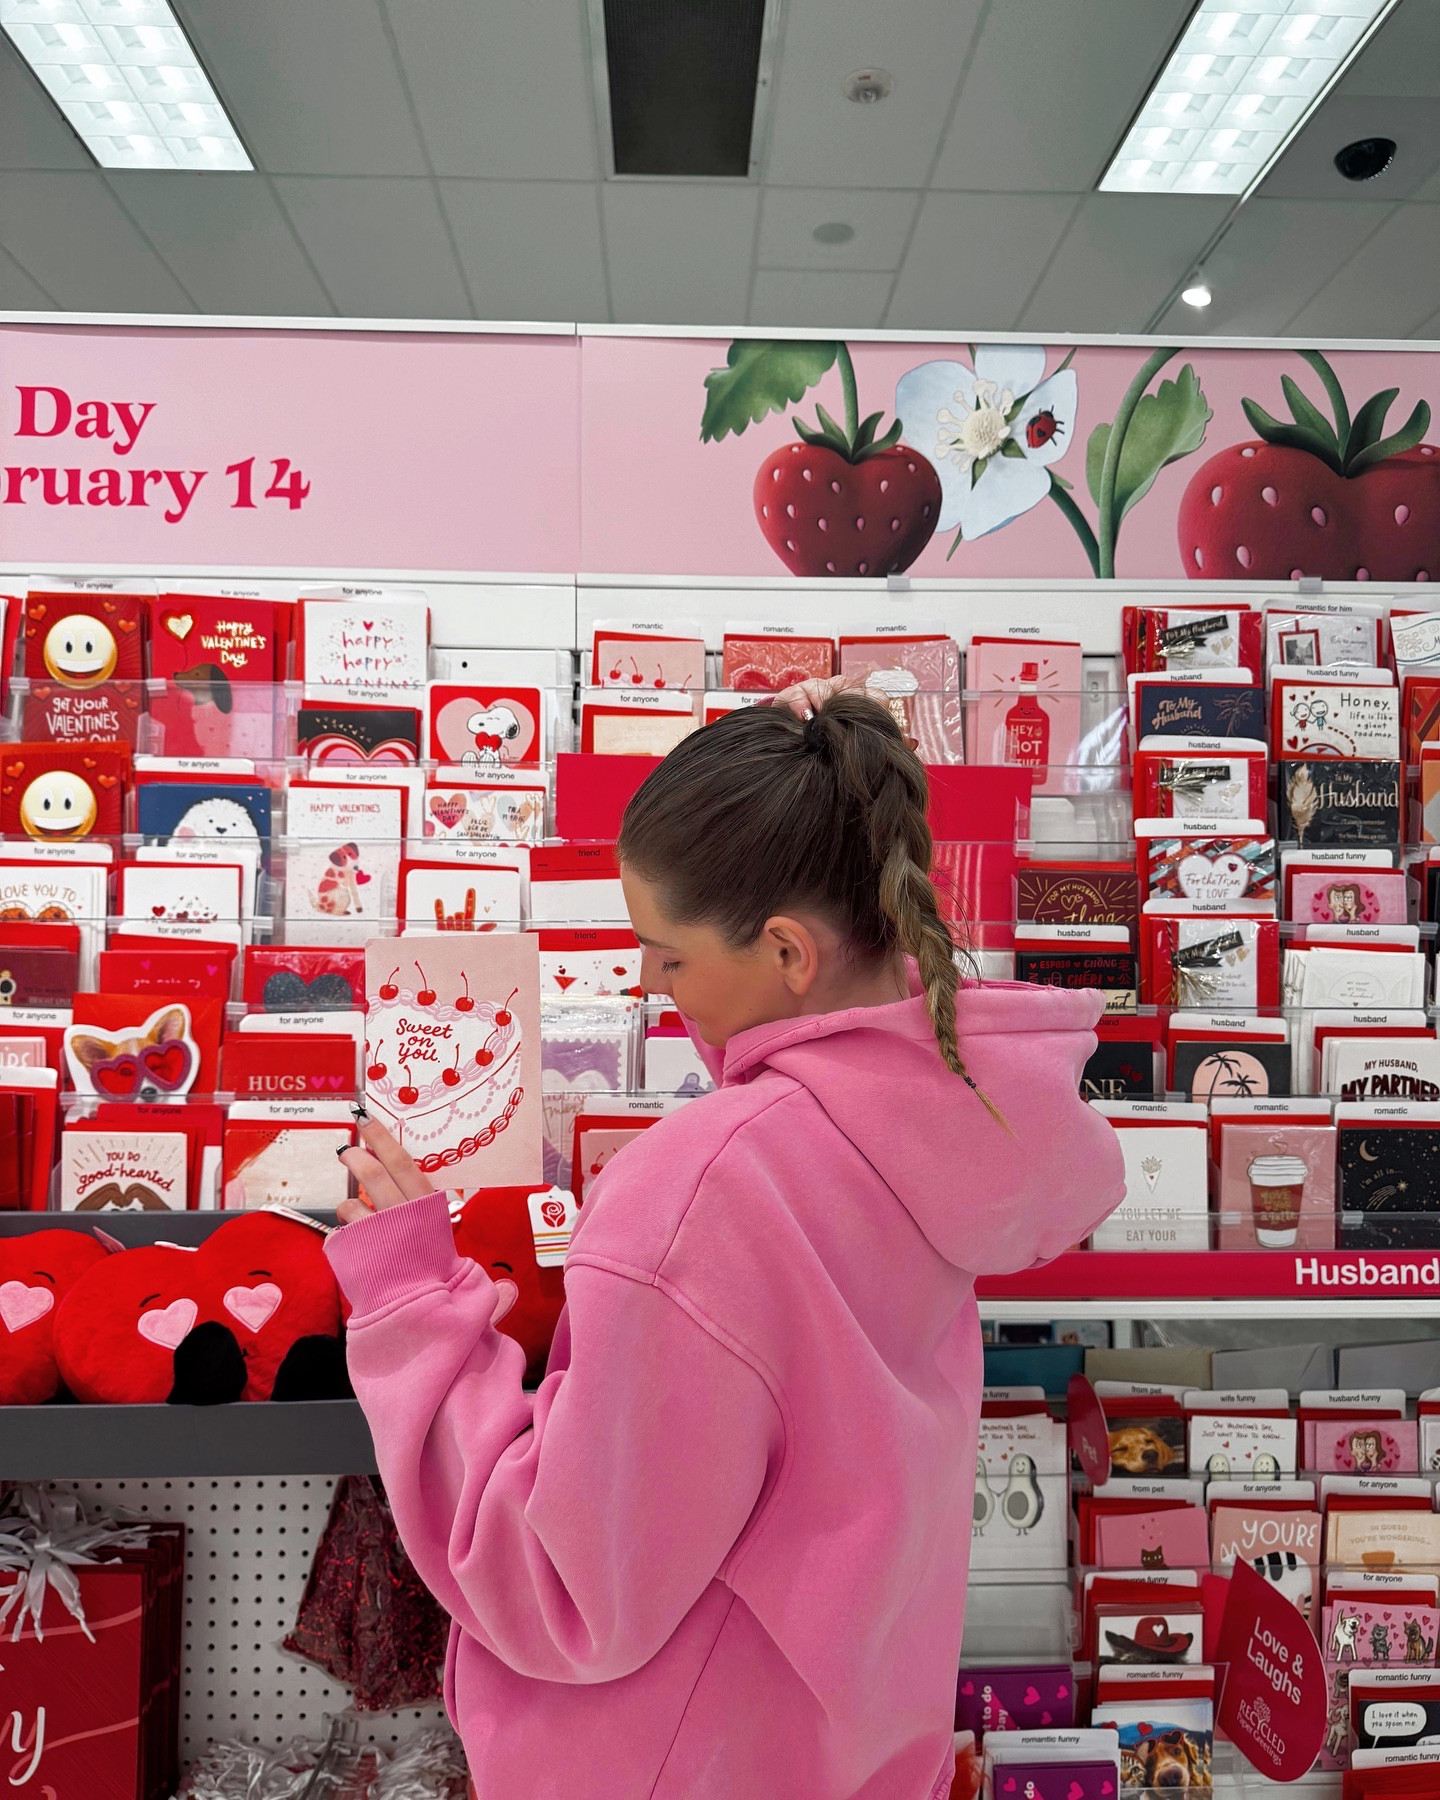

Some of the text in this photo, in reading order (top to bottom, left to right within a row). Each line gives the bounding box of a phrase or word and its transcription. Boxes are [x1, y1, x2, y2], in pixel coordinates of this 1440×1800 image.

[14, 385, 158, 455] Day
[0, 456, 311, 524] ruary 14
[216, 621, 253, 635] Happy
[876, 624, 907, 632] romantic
[201, 636, 266, 649] VALENTINE'S
[342, 631, 393, 647] happy
[343, 653, 393, 671] happy
[1171, 673, 1202, 681] husband
[1339, 670, 1359, 678] funny
[361, 690, 388, 698] anyone
[1159, 697, 1198, 712] To My
[1152, 706, 1202, 730] Husband
[1350, 712, 1365, 720] life
[1378, 712, 1393, 720] like
[1364, 722, 1387, 730] giant
[1010, 741, 1042, 755] HOT
[1312, 780, 1400, 810] Husband
[311, 804, 334, 813] HAPPY
[335, 815, 353, 825] DAY!
[442, 815, 456, 823] DAY
[456, 849, 496, 859] for anyone
[1312, 852, 1366, 861] husband funny
[34, 884, 77, 902] YOU TO
[1047, 891, 1060, 904] FOR
[1060, 884, 1071, 894] MY
[1193, 903, 1226, 911] husband
[172, 927, 201, 935] anyone
[1057, 929, 1090, 937] husband
[13, 1011, 57, 1020] for anyone
[292, 1016, 324, 1024] anyone
[1353, 1015, 1387, 1023] husband
[1211, 1018, 1246, 1028] husband
[396, 1018, 454, 1039] Sweet
[408, 1036, 434, 1048] on
[1364, 1059, 1419, 1072] MY HUSBAND,
[248, 1075, 307, 1091] HUGS
[1341, 1074, 1440, 1101] MY PARTNER
[284, 1106, 314, 1114] anyone
[629, 1101, 664, 1110] romantic
[1132, 1104, 1168, 1112] romantic
[138, 1106, 182, 1115] for anyone
[1374, 1107, 1408, 1115] romantic
[106, 1152, 141, 1161] YOU DO
[76, 1163, 176, 1194] good-hearted
[1120, 1208, 1184, 1220] YOU LET ME
[1126, 1230, 1177, 1242] EAT YOUR
[1295, 1257, 1440, 1285] Husband
[1131, 1385, 1162, 1395] from pet
[1236, 1395, 1256, 1403] funny
[1329, 1394, 1381, 1403] husband funny
[1153, 1485, 1165, 1493] pet
[1244, 1484, 1281, 1493] for anyone
[1372, 1481, 1398, 1489] anyone
[1376, 1575, 1403, 1583] anyone
[1254, 1616, 1304, 1679] Love &
[1162, 1671, 1183, 1679] funny
[1246, 1638, 1302, 1706] Laughs
[1375, 1673, 1431, 1682] romantic funny
[981, 1685, 992, 1703] do
[982, 1706, 992, 1720] to
[1379, 1711, 1393, 1719] love
[1402, 1711, 1418, 1719] when
[1240, 1699, 1286, 1754] RECYCLED
[1385, 1720, 1403, 1728] spoon
[1022, 1735, 1080, 1744] romantic funny
[1385, 1754, 1418, 1763] romantic
[1024, 1781, 1035, 1799] do
